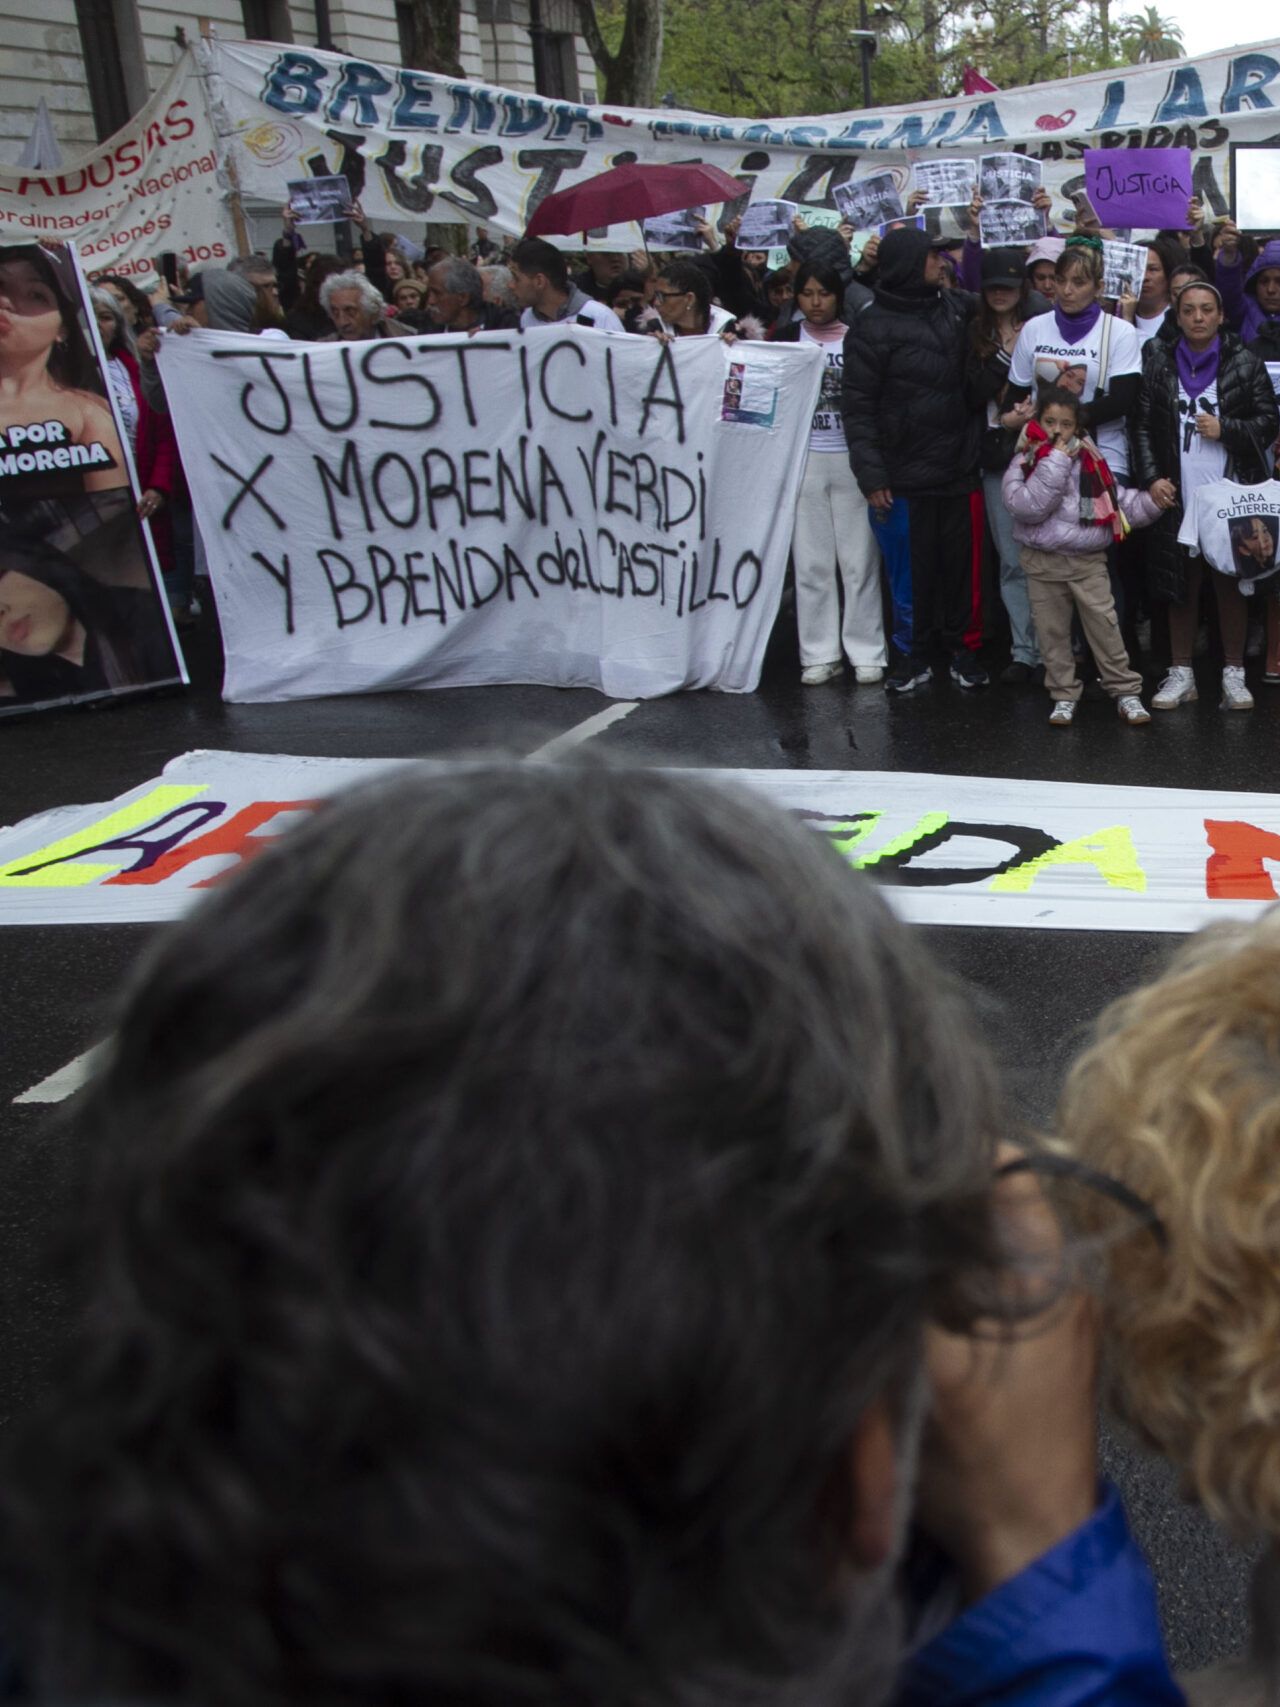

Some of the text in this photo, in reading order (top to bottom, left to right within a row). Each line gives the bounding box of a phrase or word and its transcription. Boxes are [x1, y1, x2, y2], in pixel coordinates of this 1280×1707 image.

[261, 52, 605, 143] BRENDA
[127, 150, 218, 204] Nacional
[984, 168, 1034, 180] JUSTICIA
[81, 213, 173, 257] aciones
[1034, 345, 1098, 359] MEMORIA Y
[211, 341, 686, 444] JUSTICIA
[8, 421, 66, 448] POR
[210, 452, 286, 531] X
[314, 438, 574, 540] MORENA
[1230, 492, 1266, 506] LARA
[252, 550, 297, 634] Y
[317, 538, 539, 629] BRENDA
[787, 808, 1148, 893] NDA
